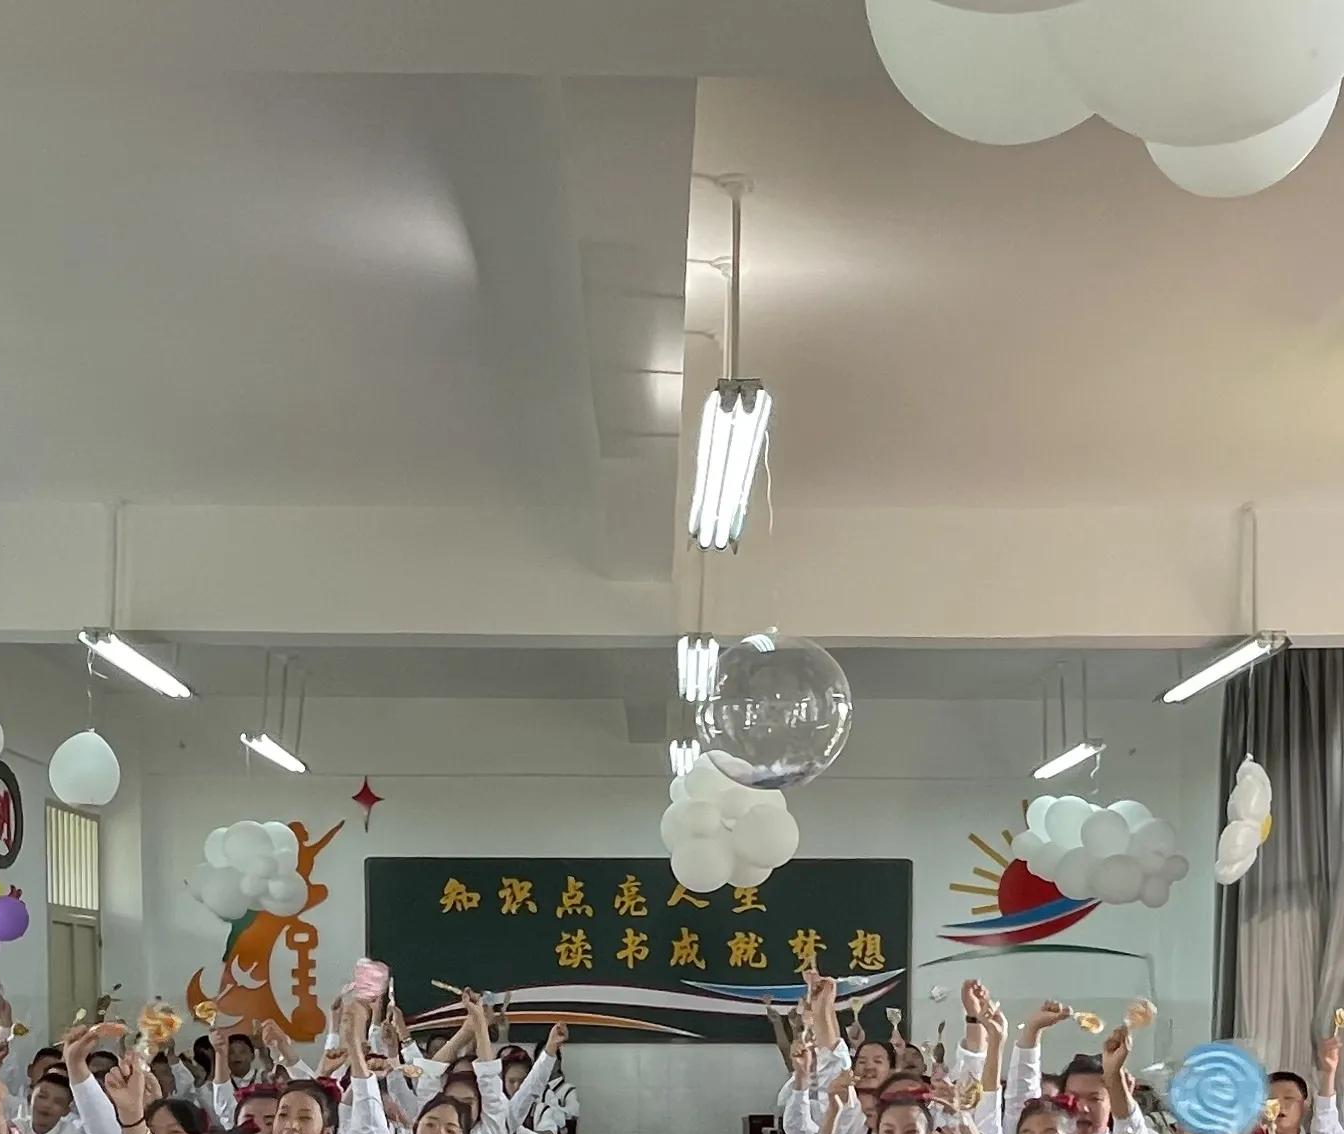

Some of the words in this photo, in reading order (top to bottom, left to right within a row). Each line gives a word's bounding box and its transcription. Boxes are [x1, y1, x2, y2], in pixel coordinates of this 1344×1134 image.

[439, 874, 767, 918] 知识点亮人生
[555, 927, 887, 974] 读书成就梦想
